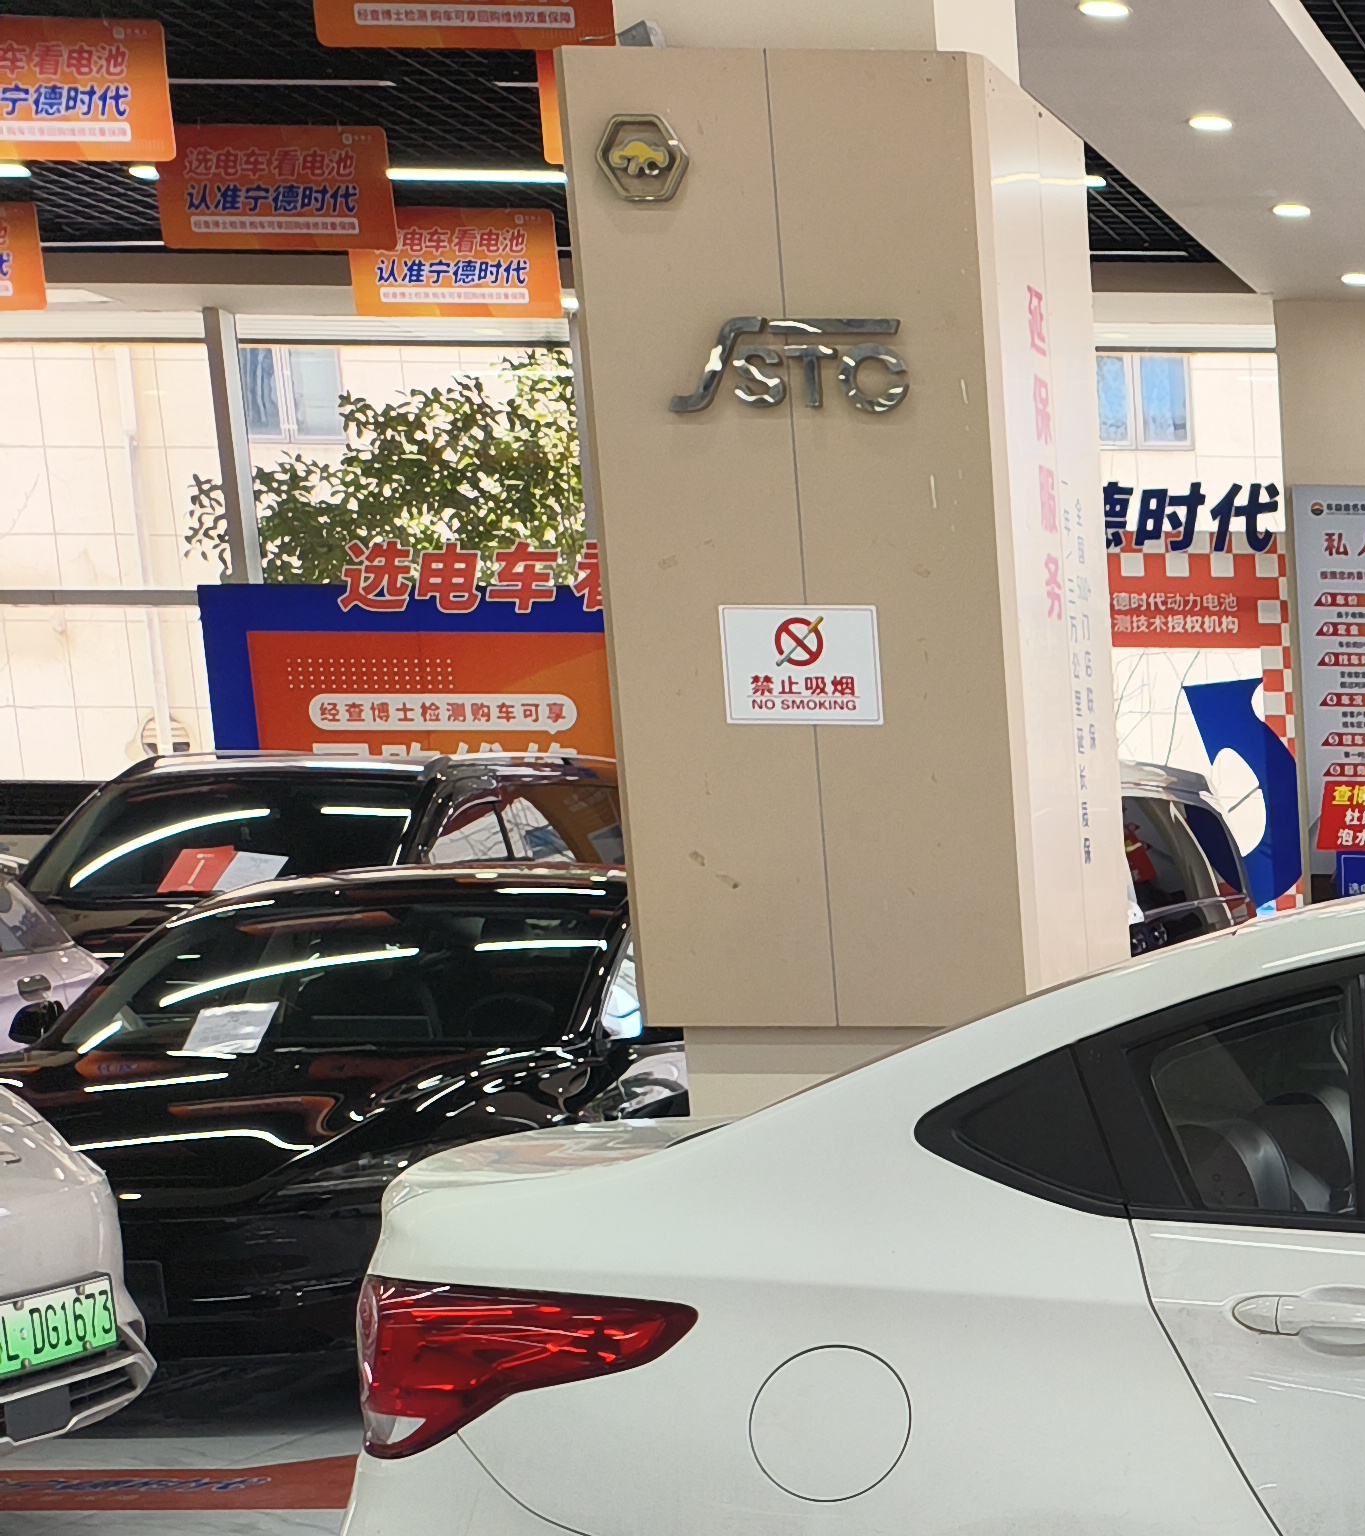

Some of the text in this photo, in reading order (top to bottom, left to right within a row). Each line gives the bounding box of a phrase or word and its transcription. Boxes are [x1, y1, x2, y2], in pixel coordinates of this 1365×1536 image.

[1, 84, 130, 118] 宁德时代
[187, 183, 359, 214] 认准宁德时代
[376, 259, 528, 286] 认准宁德时代
[750, 675, 857, 697] 禁止吸烟
[319, 702, 567, 723] 经查博士检测购车可享
[752, 699, 857, 711] NO SMOKING
[28, 1288, 113, 1355] DG1673
